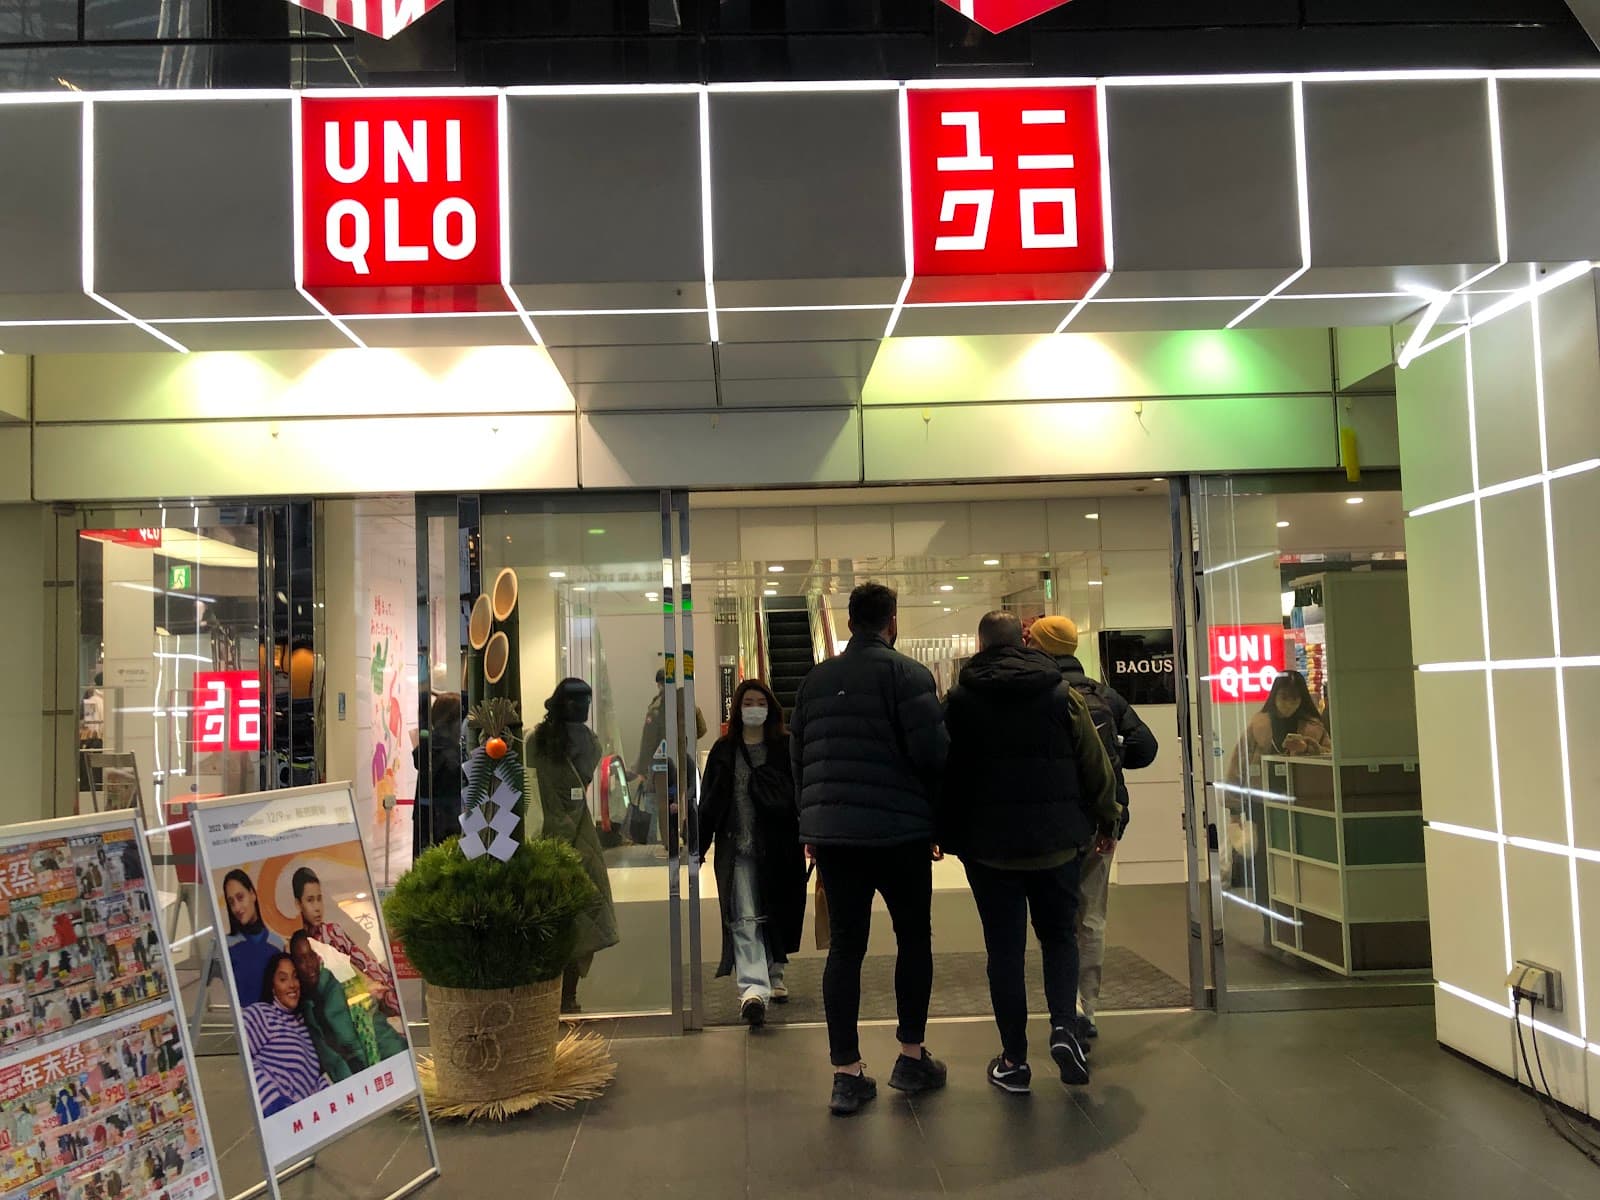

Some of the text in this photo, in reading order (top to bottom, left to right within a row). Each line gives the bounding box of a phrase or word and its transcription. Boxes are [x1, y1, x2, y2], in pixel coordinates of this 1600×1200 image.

[324, 120, 463, 184] UNI
[937, 109, 1075, 171] ユニ
[325, 197, 477, 275] QLO
[934, 187, 1078, 251] クロ
[1115, 659, 1174, 674] BAGUS
[1217, 634, 1272, 662] UNI
[1219, 665, 1279, 698] QLO
[21, 1043, 85, 1089] 年末祭
[292, 1085, 369, 1133] MARNI
